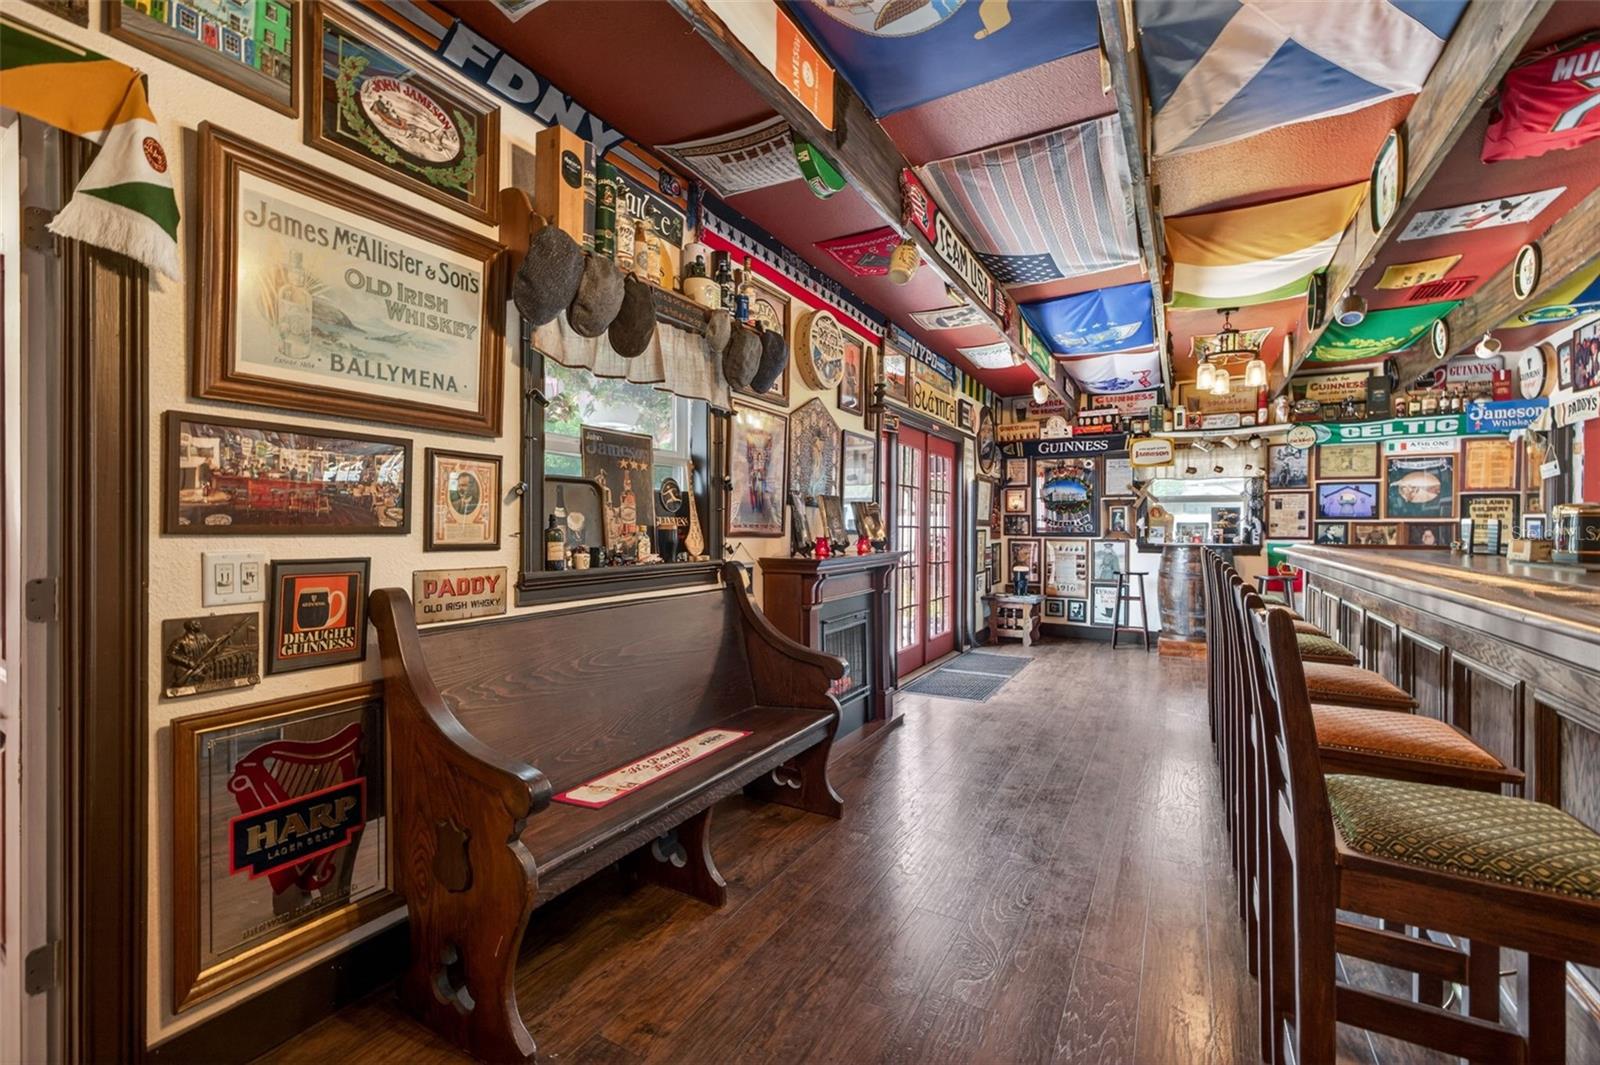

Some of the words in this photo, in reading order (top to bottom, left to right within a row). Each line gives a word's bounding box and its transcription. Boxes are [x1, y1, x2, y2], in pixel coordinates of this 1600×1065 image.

[443, 23, 625, 156] FDNY
[372, 79, 401, 93] JOHN
[403, 86, 452, 130] JAMESON
[244, 200, 329, 247] James
[424, 263, 437, 281] &
[439, 261, 480, 295] Son's
[939, 218, 968, 278] TEAM
[970, 257, 990, 302] USA
[344, 268, 393, 298] OLD
[398, 283, 449, 314] IRISH
[385, 300, 478, 340] WHISKEY
[911, 338, 938, 369] NYPD
[330, 353, 458, 393] BALLYMENA
[1449, 362, 1497, 376] GUINNESS
[1310, 381, 1368, 391] GUINNESS
[1095, 392, 1155, 404] GUINNESS
[1567, 397, 1598, 417] PADDY'S
[1469, 403, 1546, 421] Jameson
[1340, 419, 1459, 438] CELTIC
[586, 439, 650, 460] Jameson
[1038, 440, 1109, 455] GUINNESS
[423, 574, 501, 599] PADDY
[423, 604, 443, 614] OLD
[445, 601, 468, 611] IRISH
[283, 626, 355, 645] DRAUGHT
[281, 637, 354, 656] GUINNESS
[246, 796, 358, 855] HARP
[267, 840, 304, 860] LAGER
